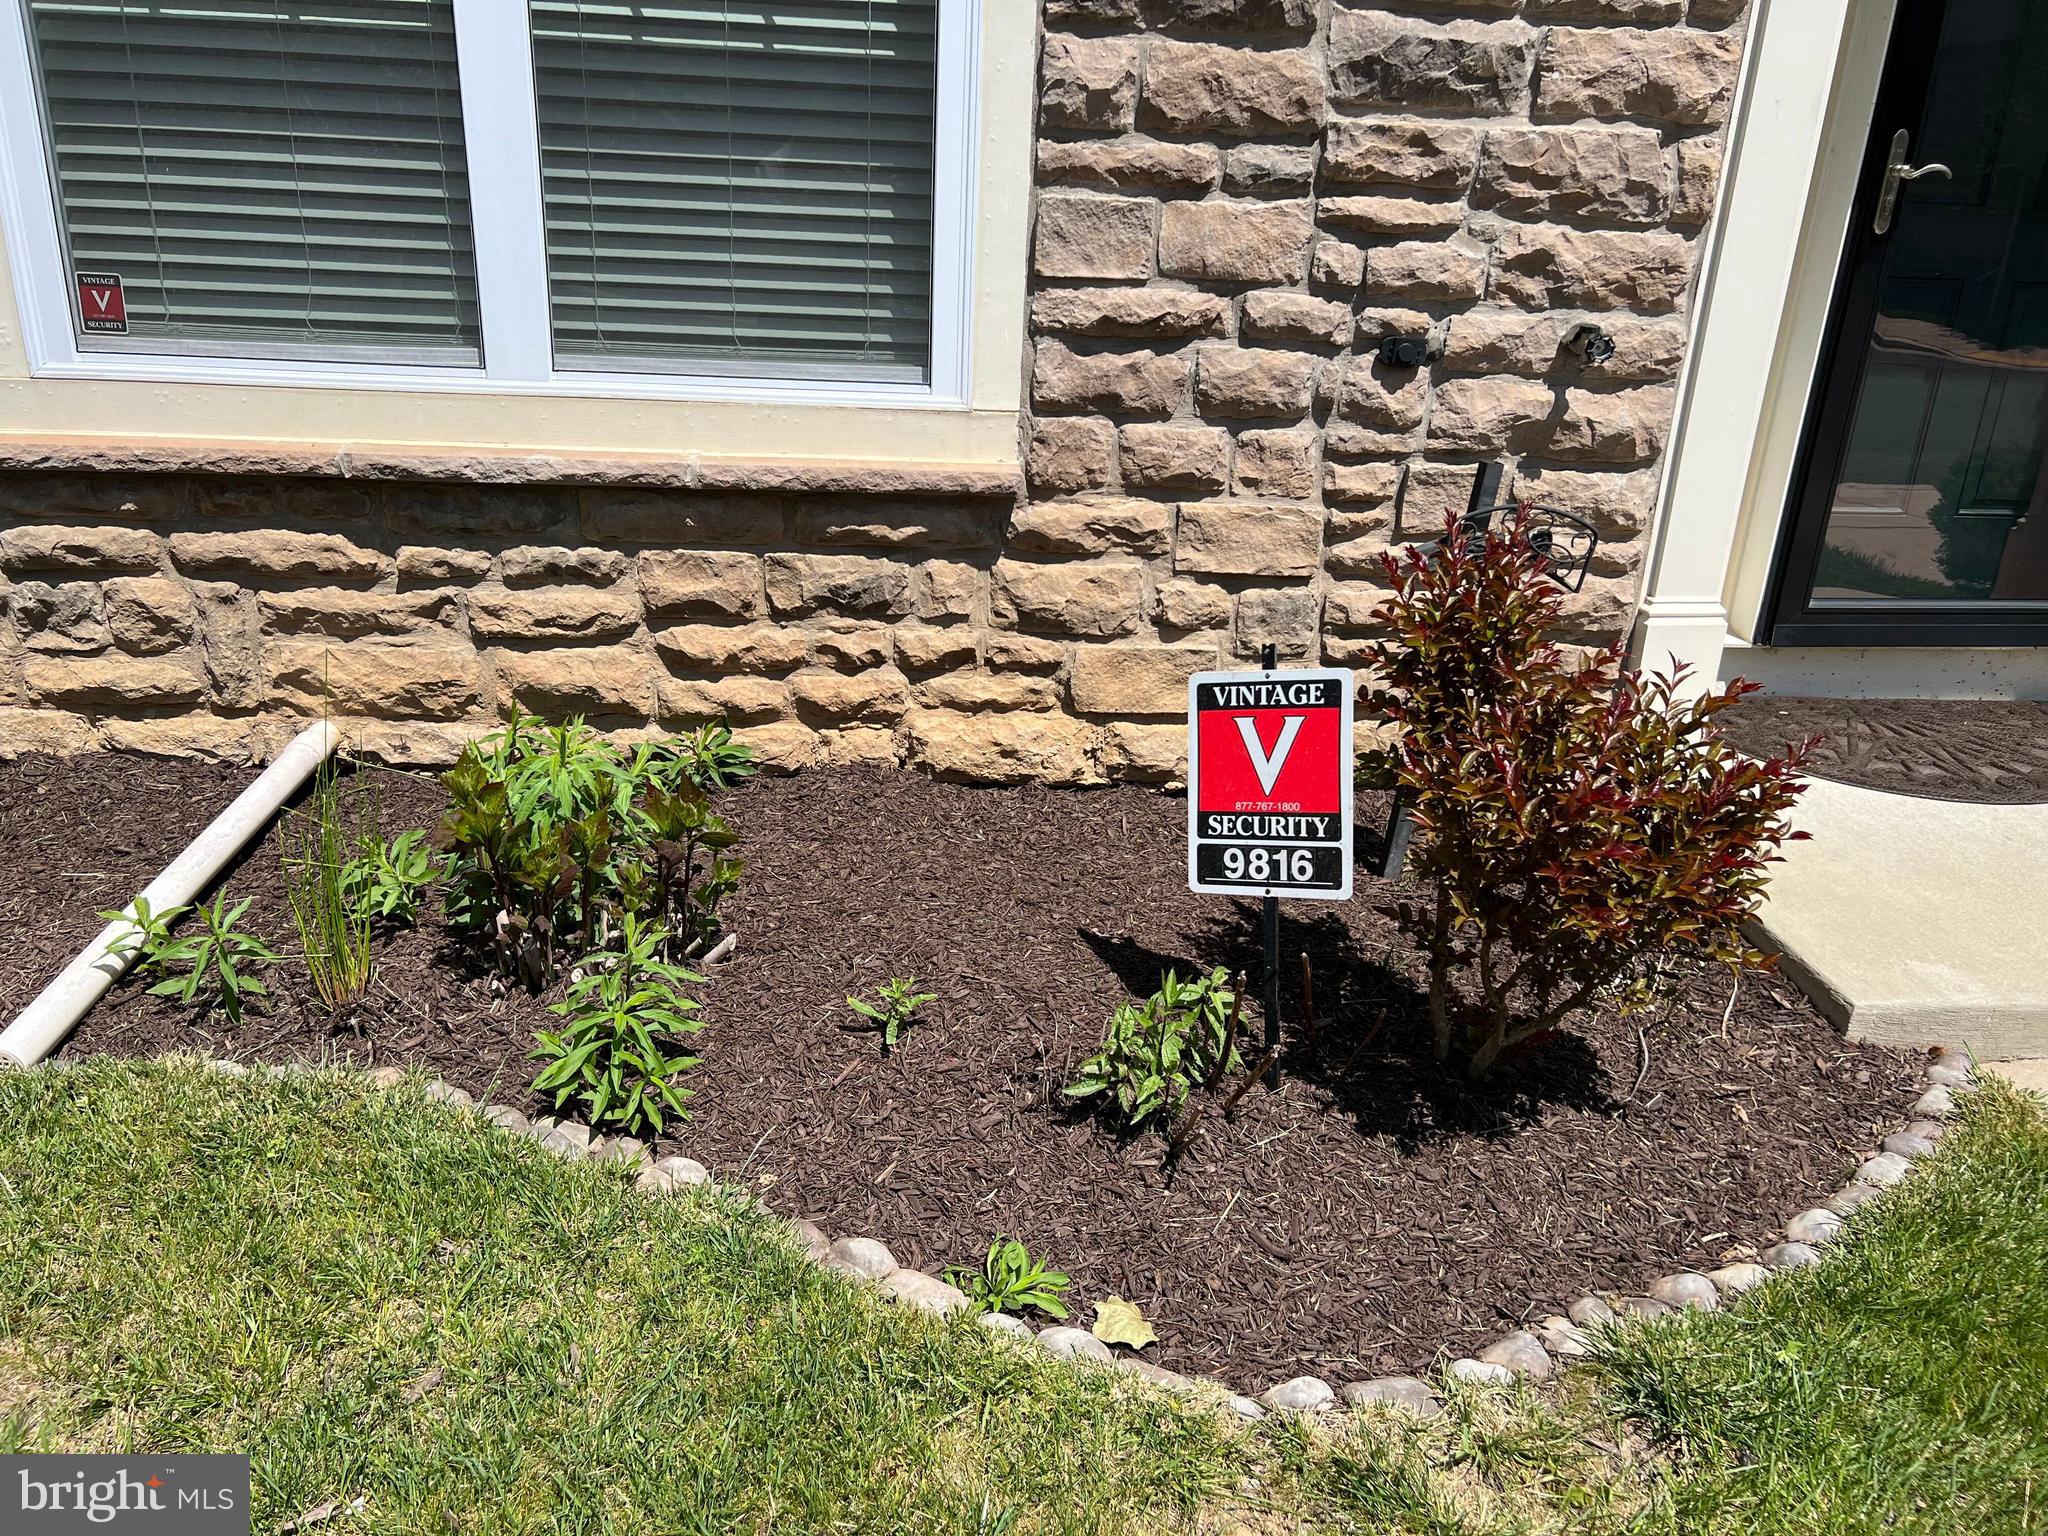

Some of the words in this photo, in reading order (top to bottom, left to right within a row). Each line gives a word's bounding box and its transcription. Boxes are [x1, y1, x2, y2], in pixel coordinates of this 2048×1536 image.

[82, 277, 116, 285] VINTAGE
[91, 290, 111, 312] V
[87, 321, 123, 329] SECURITY
[1212, 683, 1325, 707] VINTAGE
[1232, 715, 1307, 797] V
[1235, 801, 1300, 811] 877-767-1800
[1207, 814, 1329, 838] SECURITY
[1223, 847, 1314, 881] 9816
